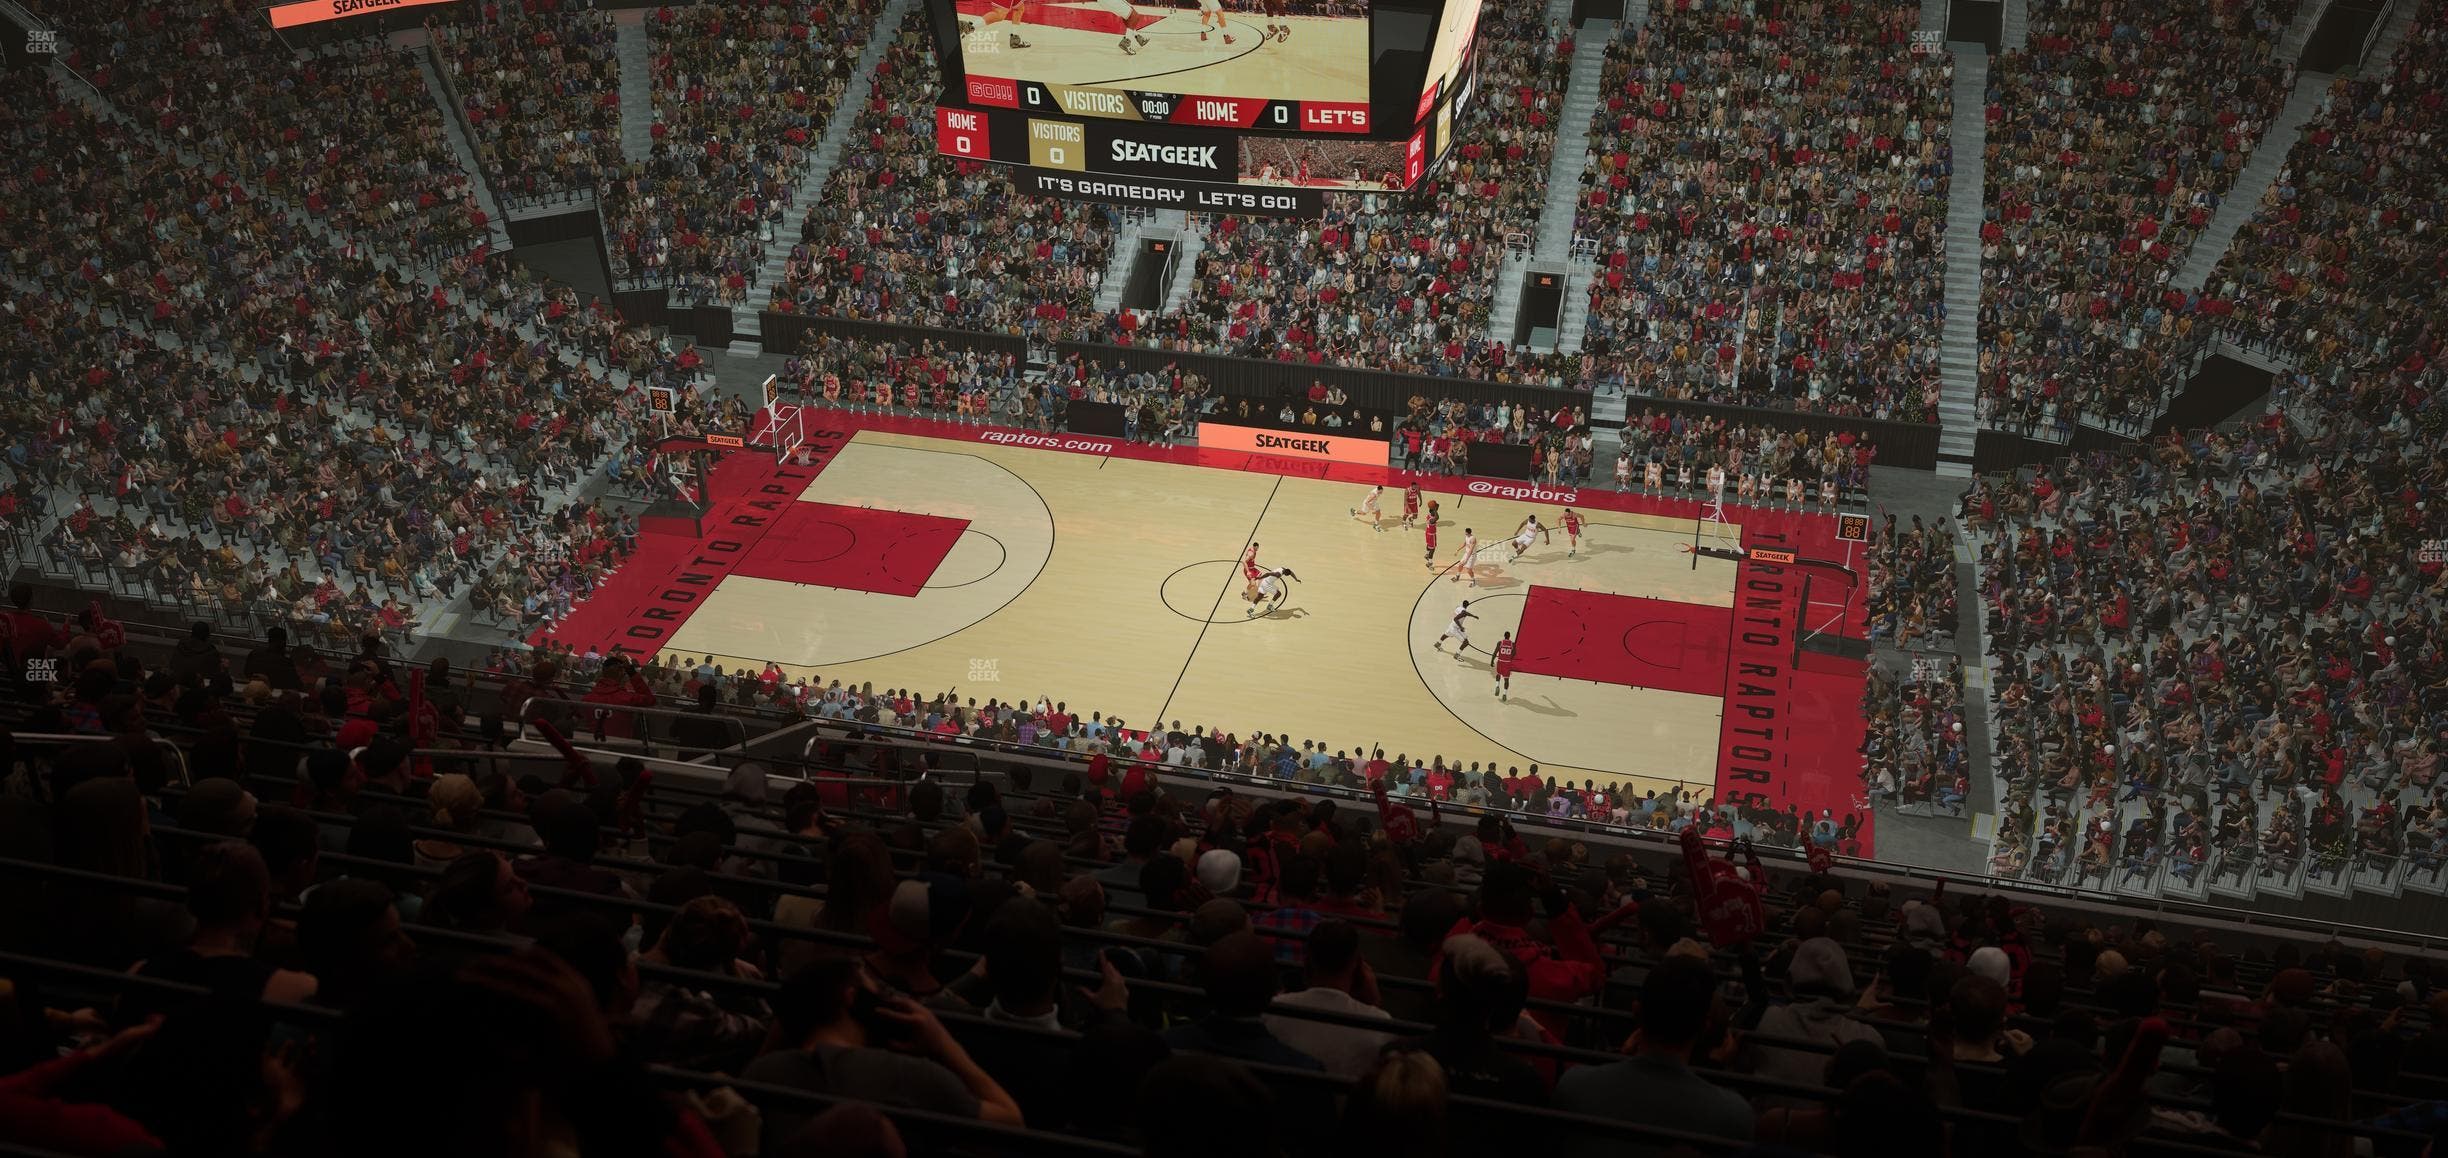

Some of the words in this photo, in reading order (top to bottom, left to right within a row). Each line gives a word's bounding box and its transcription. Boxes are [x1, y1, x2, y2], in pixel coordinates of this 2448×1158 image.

[333, 0, 401, 14] SEATG
[969, 82, 1013, 101] GO!!!
[1027, 87, 1041, 105] 0
[1064, 90, 1125, 114] VISITORS
[1142, 100, 1169, 115] 00:00
[1197, 100, 1239, 122] HOME
[948, 112, 977, 132] HOME
[1274, 105, 1288, 124] 0
[1308, 109, 1366, 125] LET'S
[1032, 122, 1081, 143] VISITORS
[956, 136, 971, 153] 0
[1112, 138, 1218, 170] SEATGEEK
[1050, 147, 1065, 164] 0
[1038, 176, 1073, 192] IT'S
[1078, 180, 1185, 202] GAMEDAY
[1199, 191, 1256, 208] LET'S
[1261, 195, 1297, 210] GO!
[711, 435, 740, 445] SEATGEEK
[980, 431, 1113, 453] raptors.com
[1255, 433, 1330, 455] SEATGEEK
[1468, 481, 1577, 503] @raptors
[609, 540, 742, 656] TORONTO
[731, 429, 844, 527] RAPTORS
[1755, 551, 1790, 561] SEATGEEK
[1742, 533, 1786, 647] TRONTO
